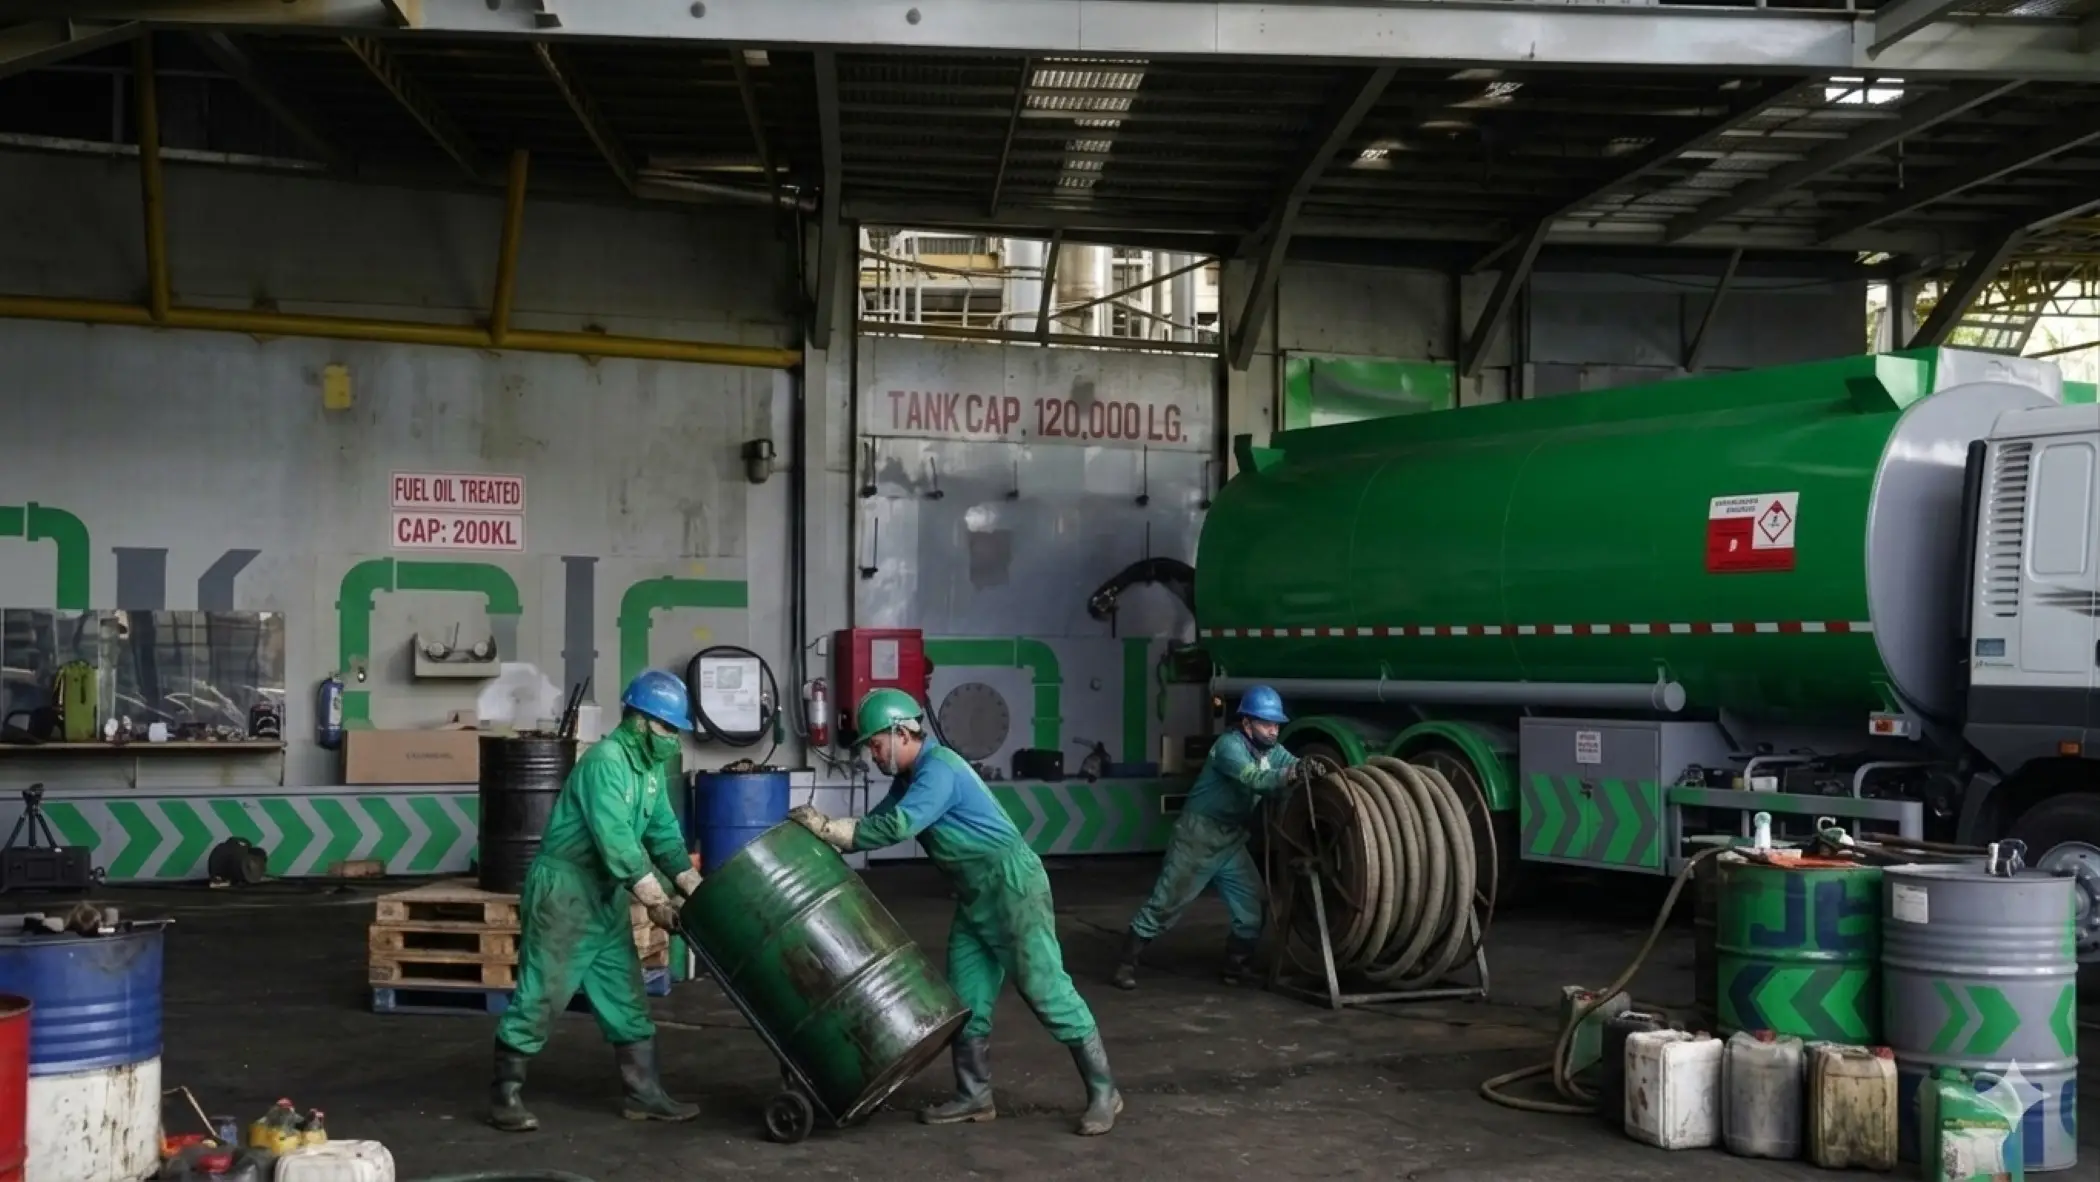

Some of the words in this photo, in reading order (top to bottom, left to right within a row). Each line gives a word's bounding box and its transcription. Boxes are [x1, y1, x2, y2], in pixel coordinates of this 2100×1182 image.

[887, 391, 960, 432] TANK
[395, 477, 429, 501] FUEL
[433, 479, 456, 502] OIL
[460, 480, 520, 504] TREATED
[398, 518, 446, 543] CAP:
[453, 520, 517, 545] 200KL
